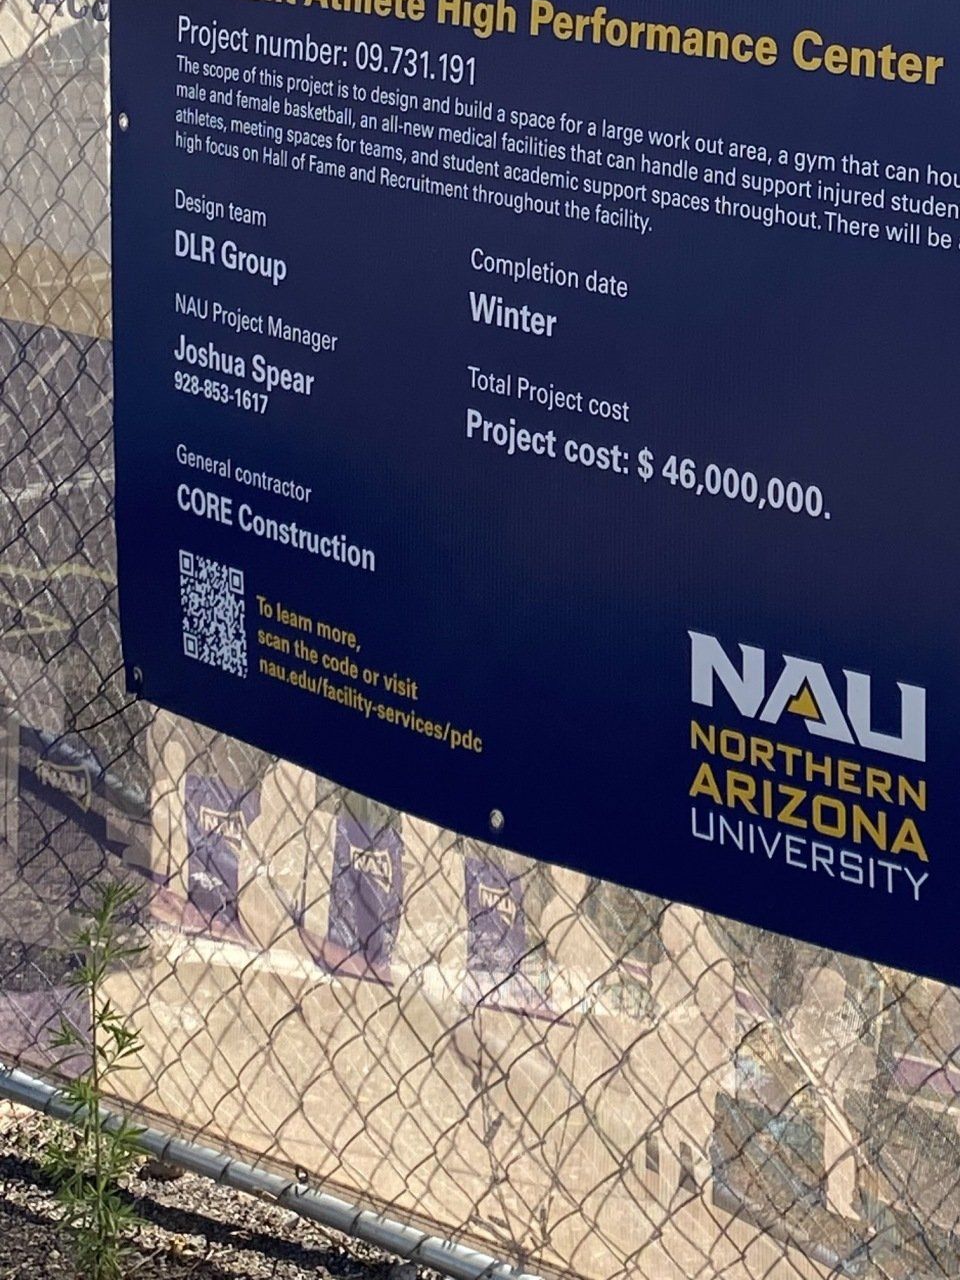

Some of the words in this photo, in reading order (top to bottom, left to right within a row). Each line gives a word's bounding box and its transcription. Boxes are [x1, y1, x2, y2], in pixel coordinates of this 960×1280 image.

[178, 15, 249, 55] Project
[255, 33, 348, 67] number:
[355, 41, 475, 86] 09.731.191
[792, 29, 945, 85] Center
[176, 54, 200, 75] The
[202, 63, 240, 83] scope
[242, 65, 257, 84] of
[259, 68, 284, 89] this
[286, 75, 334, 97] project
[337, 79, 349, 99] is
[352, 83, 367, 102] to
[370, 85, 419, 112] design
[422, 95, 451, 114] and
[454, 97, 493, 121] build
[496, 108, 506, 123] a
[509, 110, 556, 131] space
[559, 112, 584, 134] for
[587, 121, 597, 137] a
[601, 118, 644, 147] large
[647, 130, 691, 151] work
[695, 137, 724, 156] out
[728, 142, 773, 166] area,
[777, 149, 789, 165] a
[794, 152, 835, 173] gym
[841, 153, 880, 178] that
[885, 164, 920, 183] can
[176, 83, 207, 102] male
[209, 88, 233, 106] and
[235, 89, 281, 114] female
[283, 97, 356, 129] basketball,
[359, 114, 377, 130] an
[381, 114, 435, 139] all-new
[438, 126, 497, 149] medical
[501, 131, 567, 161] facilities
[569, 143, 603, 166] that
[606, 153, 635, 171] can
[641, 153, 699, 181] handle
[703, 167, 736, 187] and
[741, 173, 813, 199] support
[817, 179, 885, 209] injured
[175, 107, 227, 133] athletes,
[230, 119, 283, 145] meeting
[286, 129, 333, 149] spaces
[335, 132, 357, 153] for
[359, 138, 407, 165] teams,
[411, 149, 439, 167] and
[442, 153, 500, 178] student
[503, 165, 579, 191] academic
[583, 178, 647, 202] support
[651, 189, 710, 212] spaces
[713, 195, 822, 231] throughout.
[823, 210, 880, 239] There
[885, 222, 920, 245] will
[927, 225, 952, 249] be
[175, 130, 203, 154] high
[205, 135, 239, 159] focus
[242, 147, 259, 163] on
[262, 146, 288, 168] Hall
[291, 152, 307, 171] of
[309, 154, 346, 179] Fame
[349, 165, 377, 184] and
[380, 167, 469, 200] Recruitment
[472, 183, 561, 217] throughout
[564, 199, 591, 221] the
[595, 203, 654, 235] facility.
[175, 188, 225, 221] Design
[228, 202, 267, 227] team
[175, 229, 215, 265] DLR
[221, 240, 287, 286] Group
[471, 247, 579, 289] Completion
[585, 269, 628, 298] date
[175, 292, 209, 319] NAU
[212, 301, 264, 334] Project
[267, 315, 339, 353] Manager
[469, 291, 557, 337] Winter
[173, 334, 245, 378] Joshua
[251, 353, 315, 395] Spear
[174, 370, 269, 415] 928-853-1617
[467, 365, 511, 397] Total
[517, 376, 583, 413] Project
[588, 398, 630, 423] cost
[176, 443, 231, 479] General
[235, 467, 312, 503] contractor
[466, 407, 557, 458] Project
[564, 439, 629, 475] cost:
[637, 446, 654, 483] $
[661, 455, 831, 520] 46,000,000.
[177, 483, 233, 526] CORE
[238, 503, 375, 572] Construction
[256, 595, 273, 618] To
[276, 602, 313, 633] learn
[317, 622, 361, 652] more,
[257, 630, 290, 654] scan
[294, 640, 319, 665] the
[321, 654, 359, 679] code
[363, 669, 380, 686] or
[383, 673, 418, 700] visit
[686, 629, 927, 763] NAU
[259, 659, 482, 753] nau.edu/facility-services/pdc
[690, 719, 927, 812] NORTHERN
[688, 761, 930, 863] ARIZONA
[691, 806, 930, 902] UNIVERSITY
